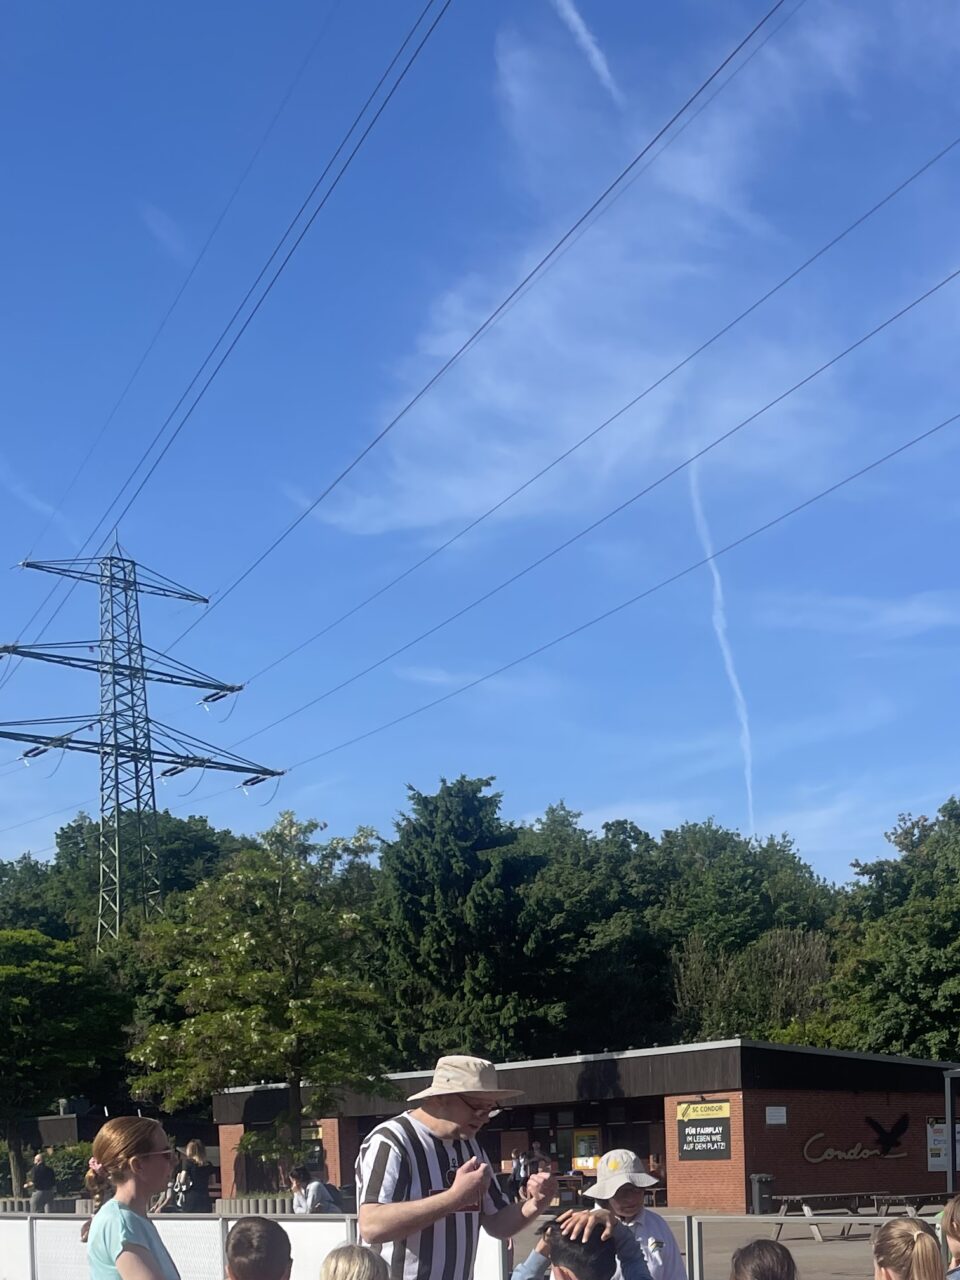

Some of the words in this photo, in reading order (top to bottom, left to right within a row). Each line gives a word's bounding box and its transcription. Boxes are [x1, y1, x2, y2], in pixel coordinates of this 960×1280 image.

[685, 1126, 696, 1135] FÜR
[697, 1126, 722, 1134] FAIRPLAY
[711, 1134, 722, 1142] WIE
[694, 1142, 707, 1150] DEM
